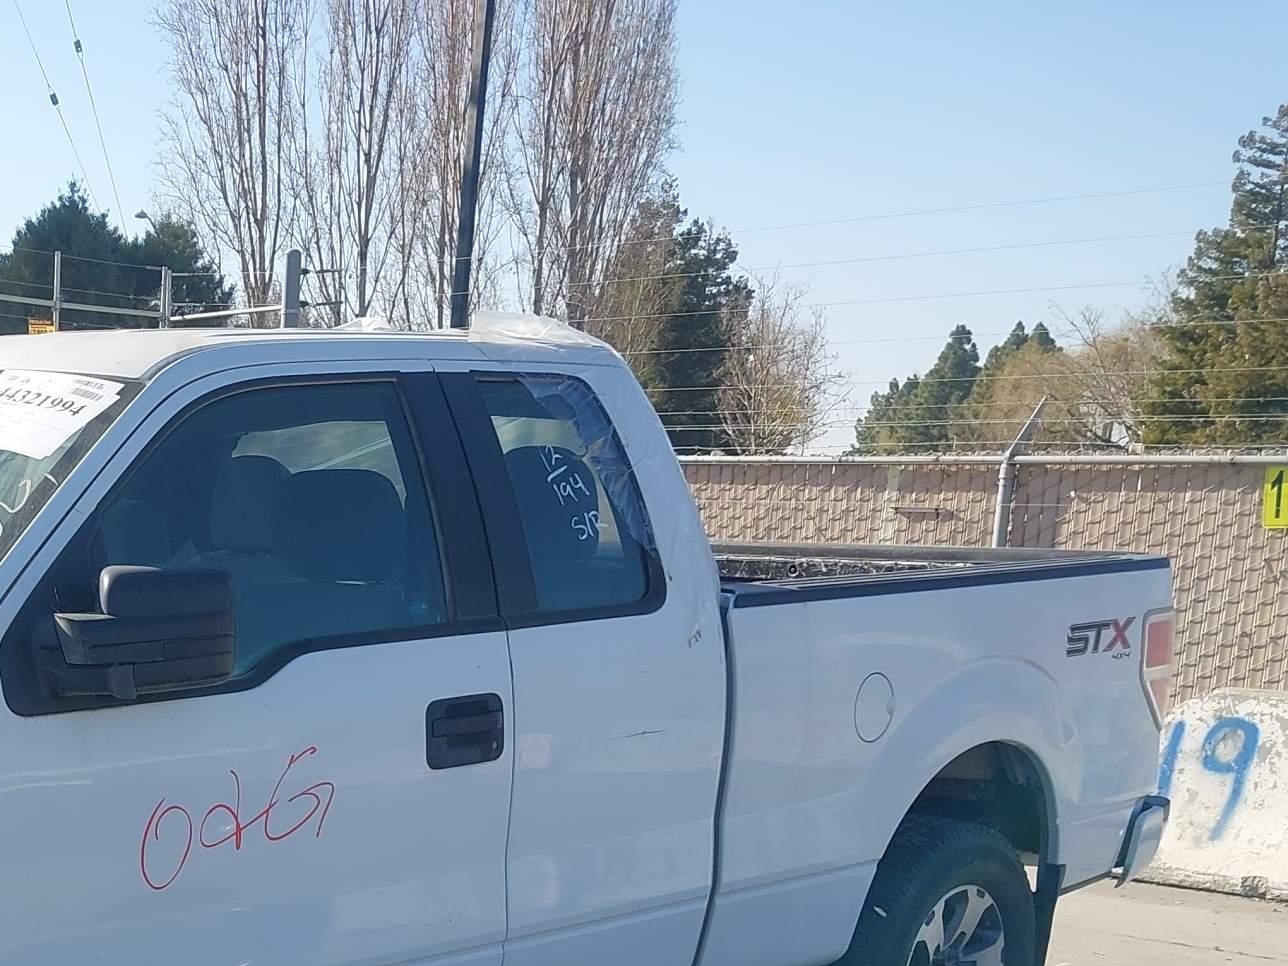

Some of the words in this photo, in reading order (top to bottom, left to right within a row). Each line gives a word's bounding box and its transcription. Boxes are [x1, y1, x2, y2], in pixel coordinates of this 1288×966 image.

[552, 472, 591, 506] 194
[1066, 616, 1137, 658] STX
[1156, 716, 1260, 842] 19
